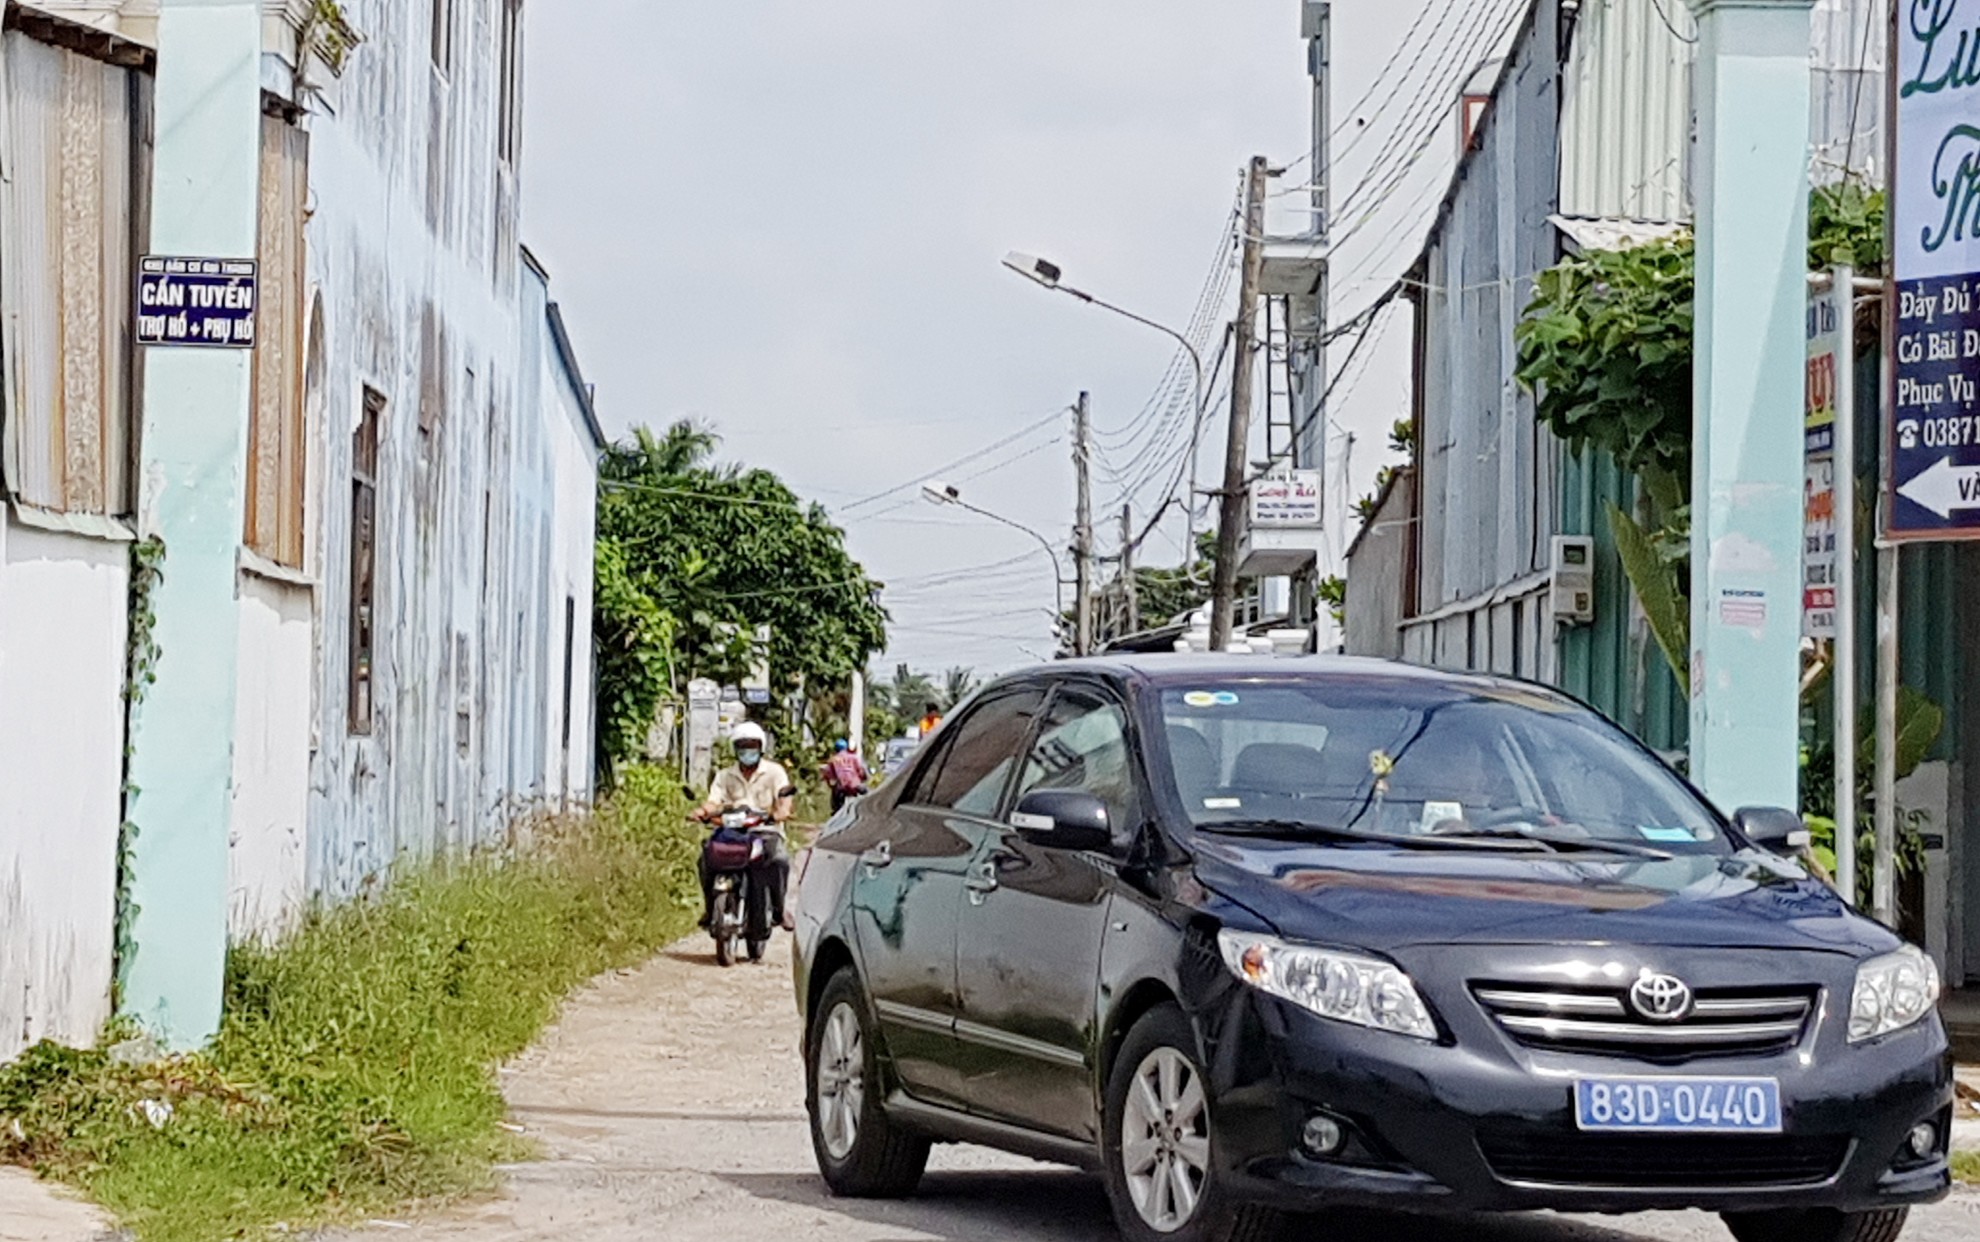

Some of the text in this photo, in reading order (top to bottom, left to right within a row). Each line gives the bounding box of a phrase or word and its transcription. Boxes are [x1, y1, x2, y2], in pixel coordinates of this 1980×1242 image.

[1898, 331, 1922, 363] Có
[1927, 331, 1957, 361] Bãi
[1898, 374, 1975, 412] Phục Vụ
